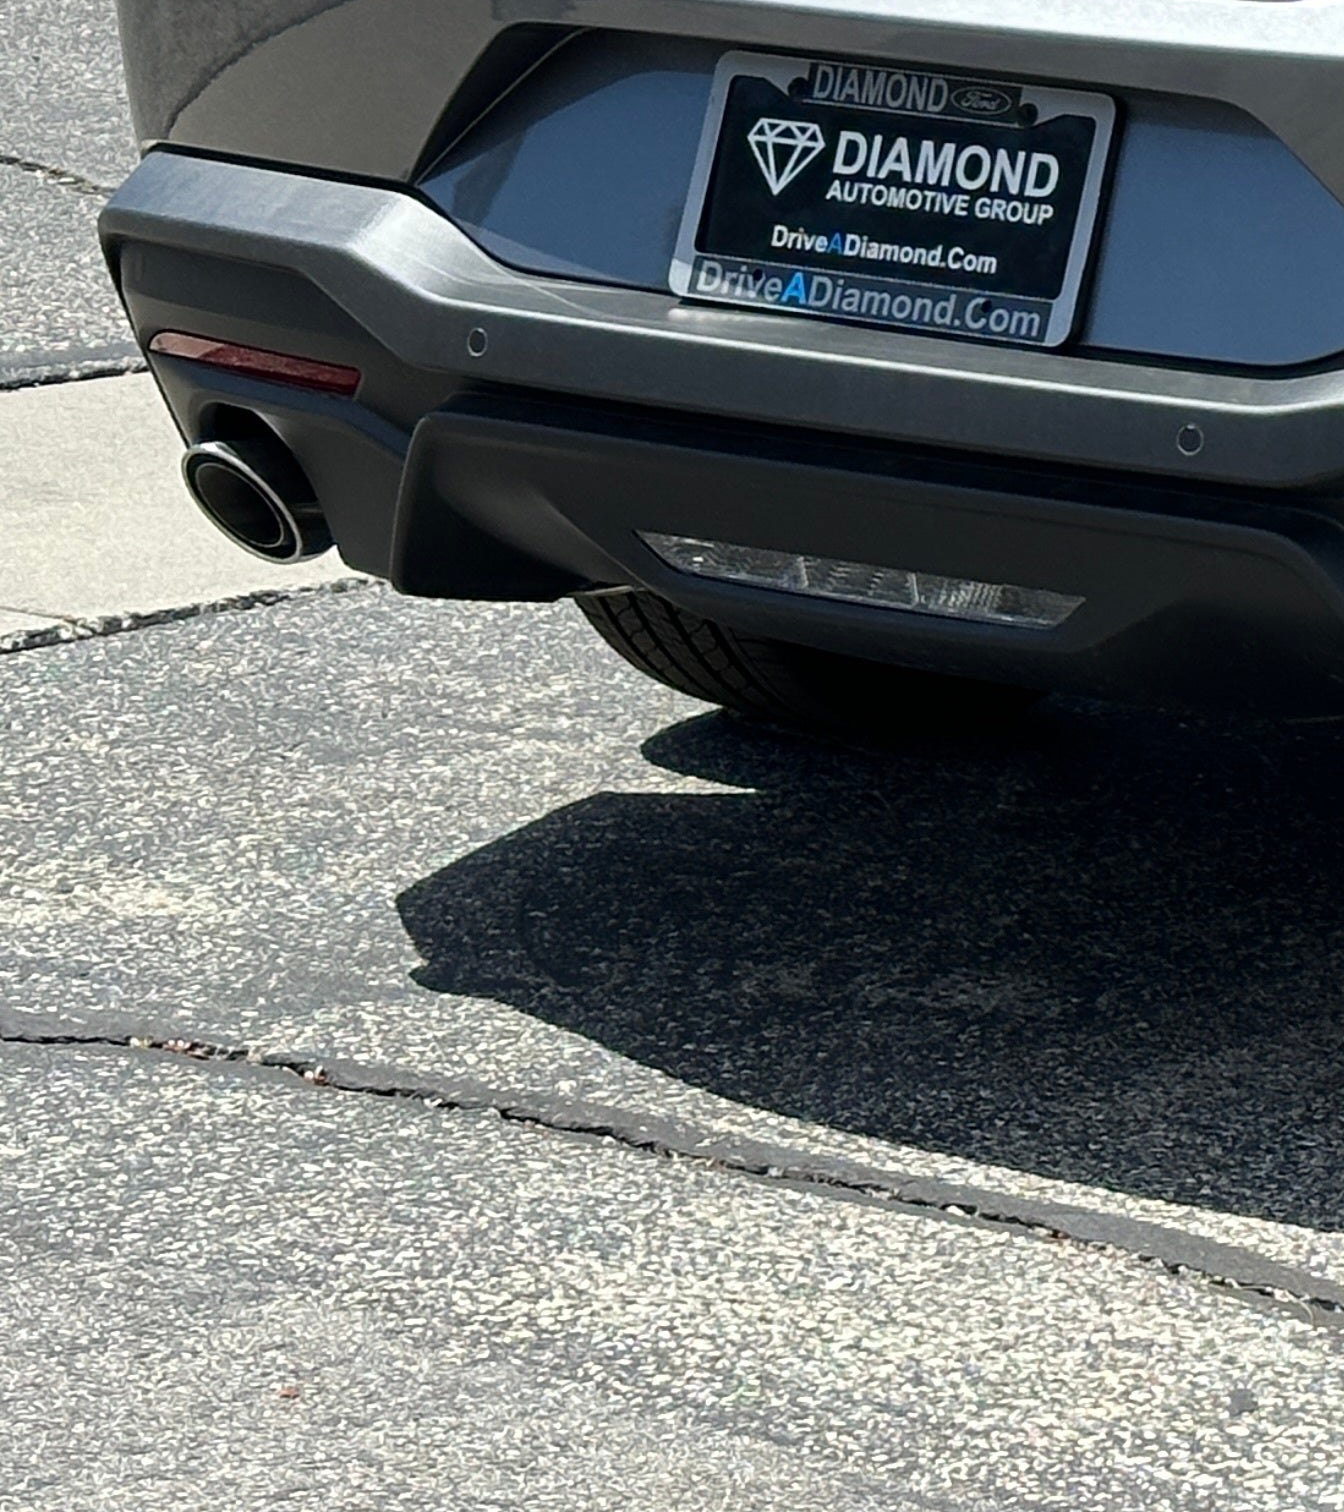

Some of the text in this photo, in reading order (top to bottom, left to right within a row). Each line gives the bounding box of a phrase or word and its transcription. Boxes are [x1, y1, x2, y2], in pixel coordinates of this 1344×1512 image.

[812, 64, 949, 113] DIAMOND
[832, 130, 1060, 198] DIAMOND
[826, 180, 1054, 227] AUTOMOTIVE GROUP
[770, 224, 998, 275] DriveADiamond.Com
[696, 260, 1042, 338] DriveADiamond.Com
